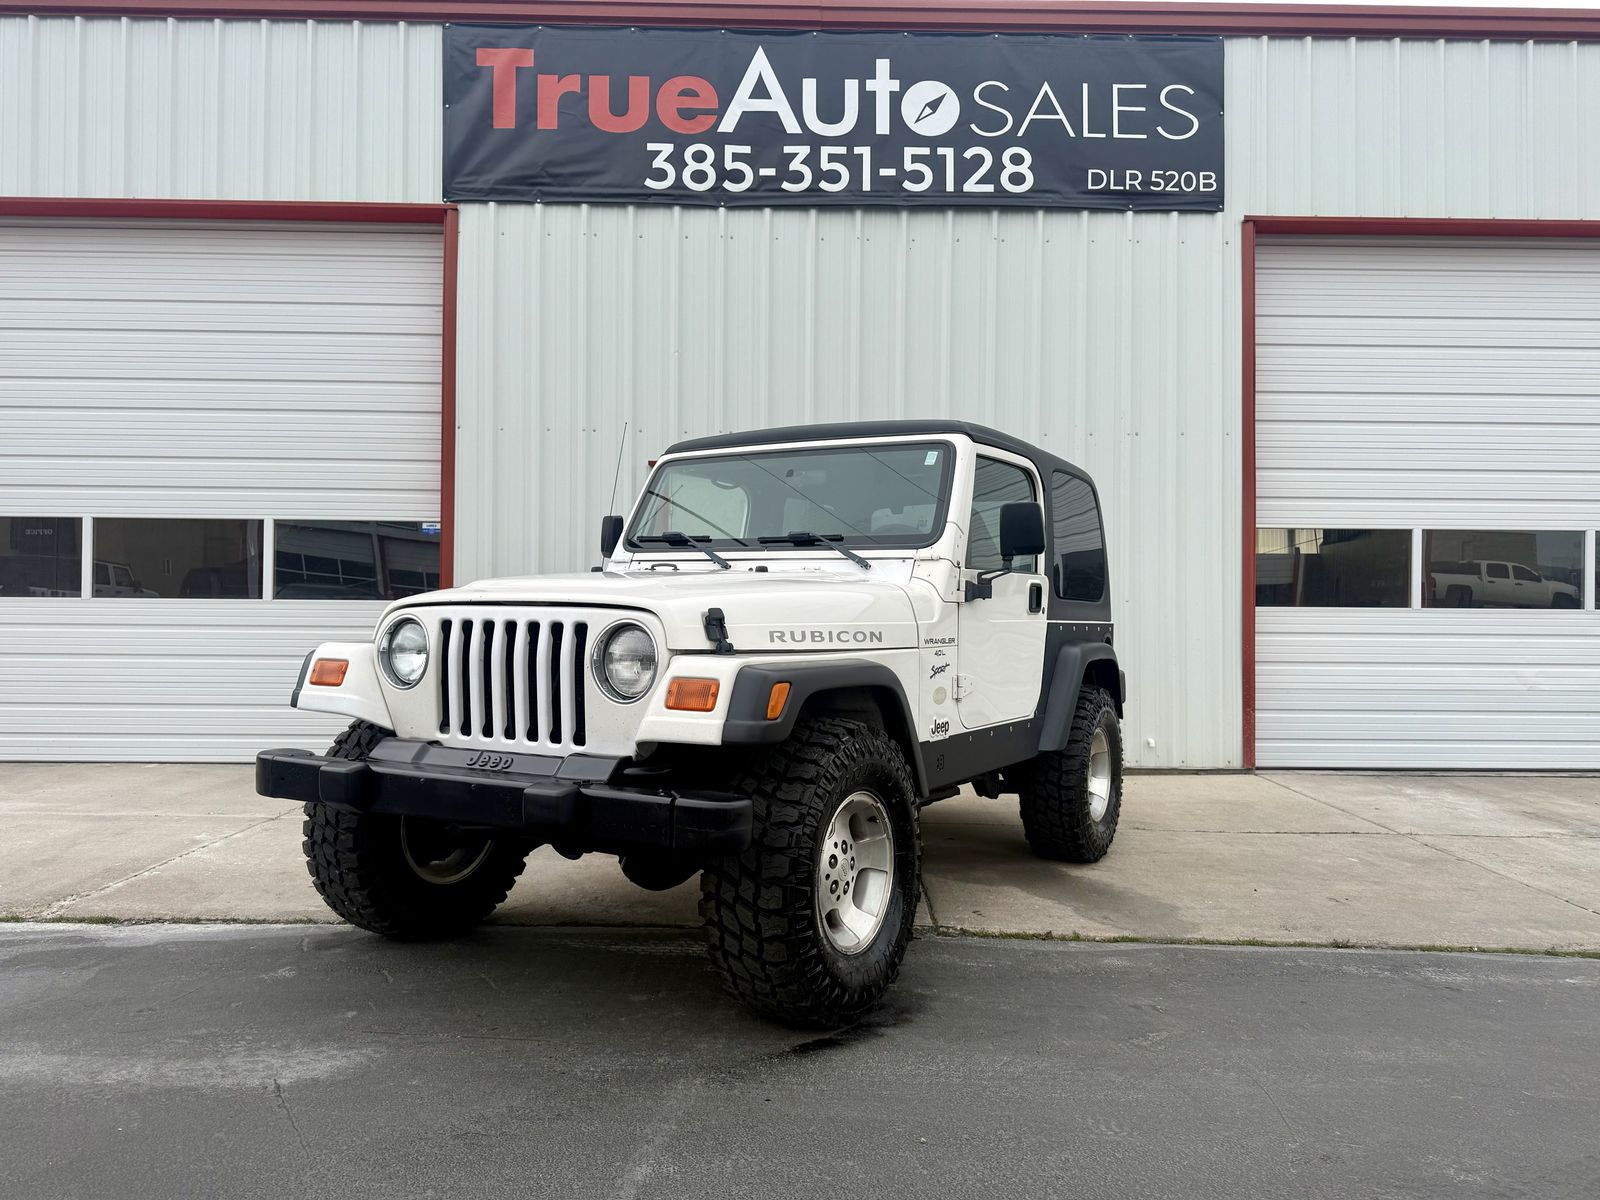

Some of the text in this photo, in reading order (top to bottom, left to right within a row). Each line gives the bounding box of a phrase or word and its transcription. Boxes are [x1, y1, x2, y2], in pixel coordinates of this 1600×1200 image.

[970, 81, 1199, 140] SALES
[643, 142, 1035, 194] 385-351-5128
[1087, 168, 1217, 193] DLR 520B
[768, 630, 883, 643] RUBICON
[924, 637, 956, 645] WRANGLER
[931, 719, 949, 736] Jeep
[466, 750, 514, 770] Jeep
